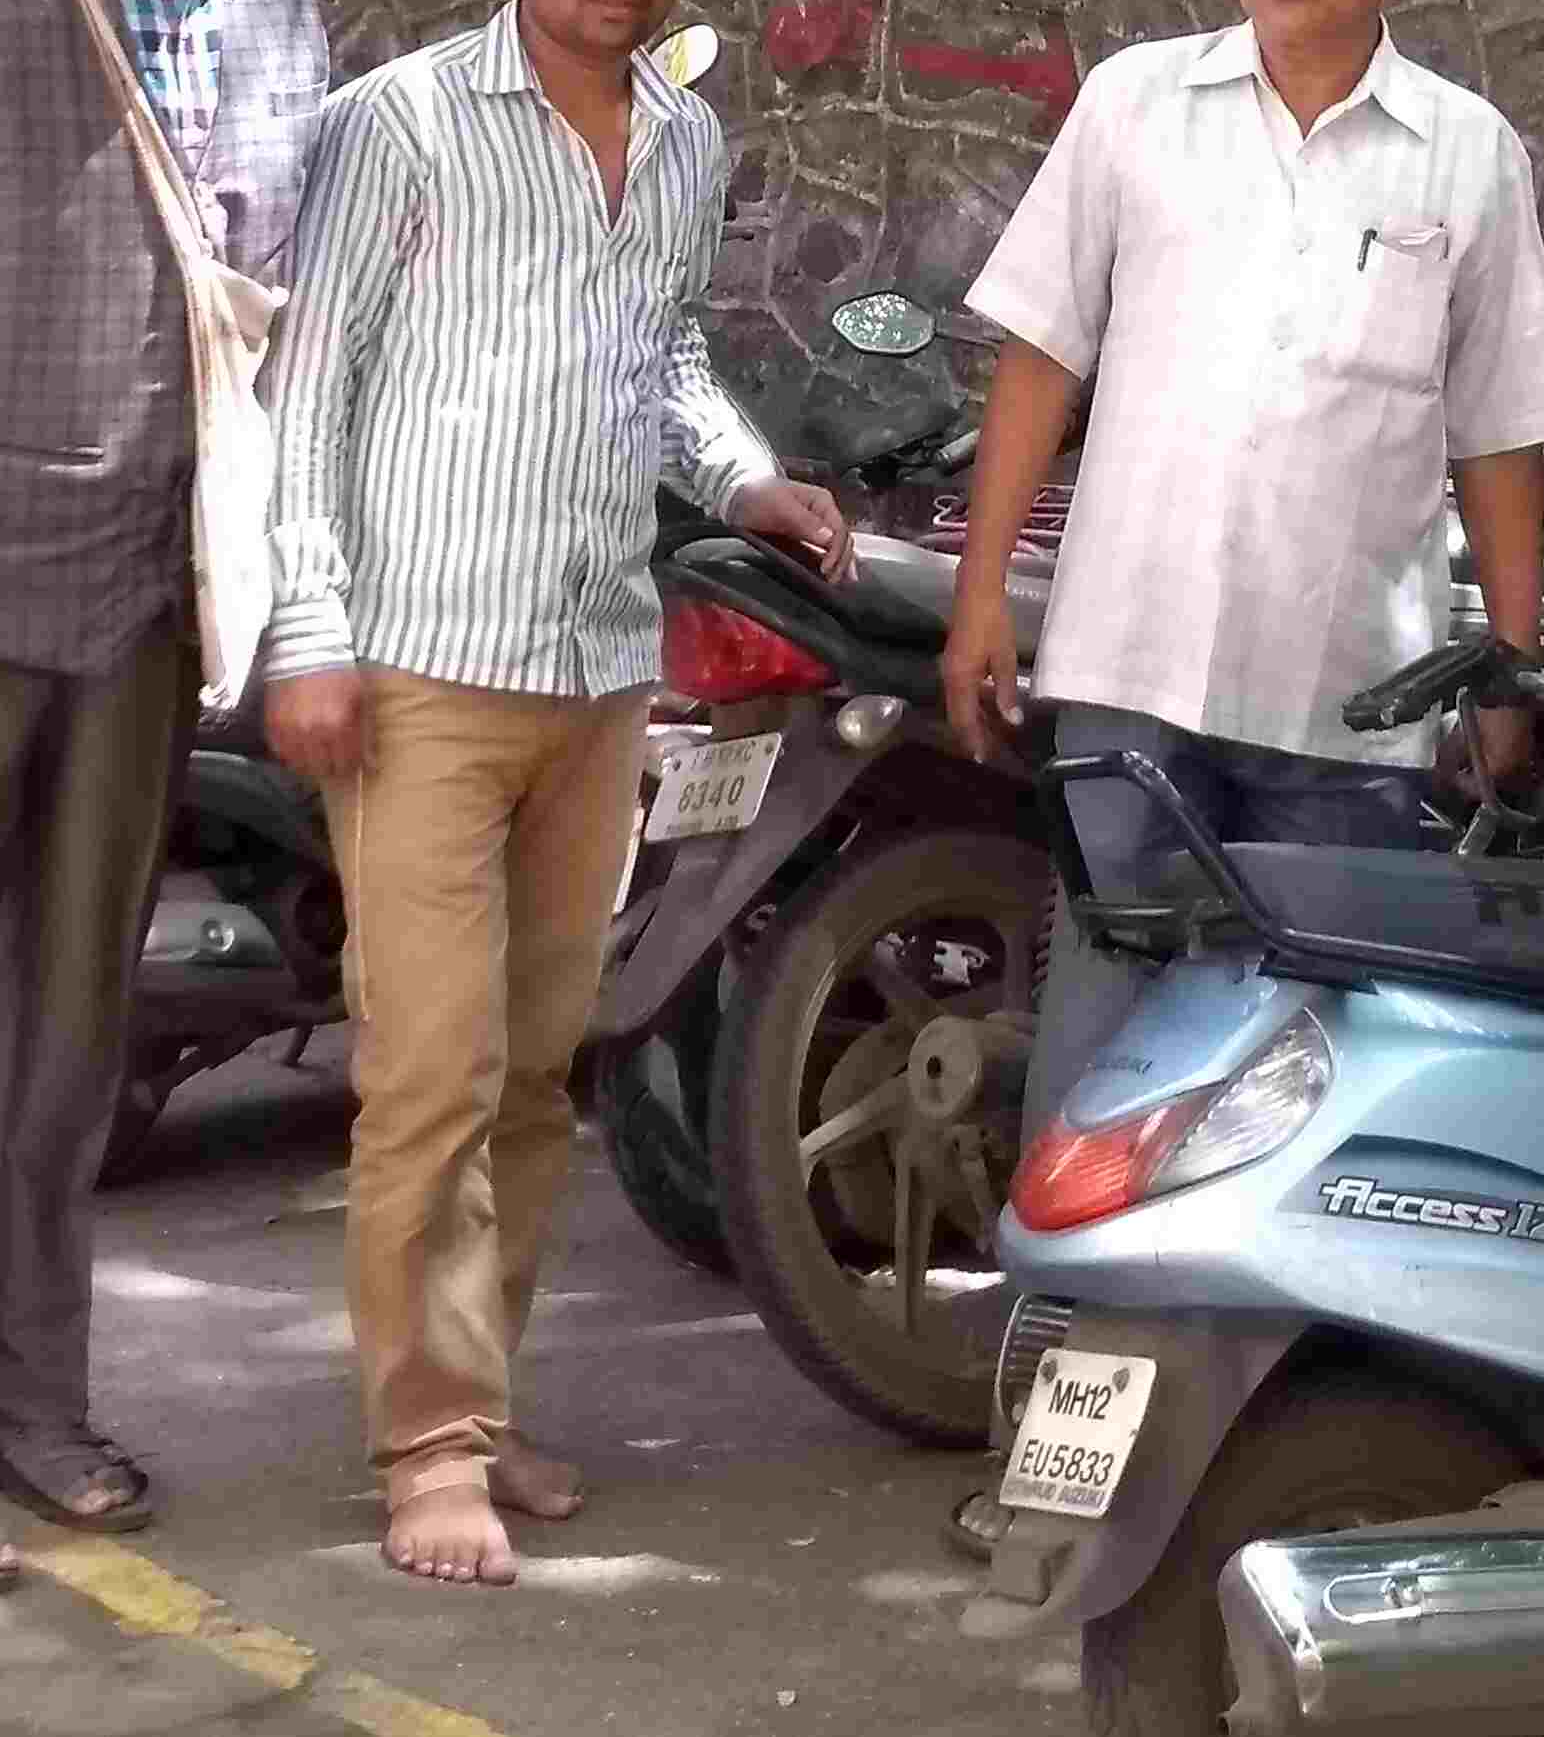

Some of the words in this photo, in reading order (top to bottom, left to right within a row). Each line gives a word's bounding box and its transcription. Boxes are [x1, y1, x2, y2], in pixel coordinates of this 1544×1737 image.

[1318, 1174, 1507, 1235] Access
[1048, 1378, 1113, 1421] MH12
[1018, 1438, 1115, 1487] EU5833
